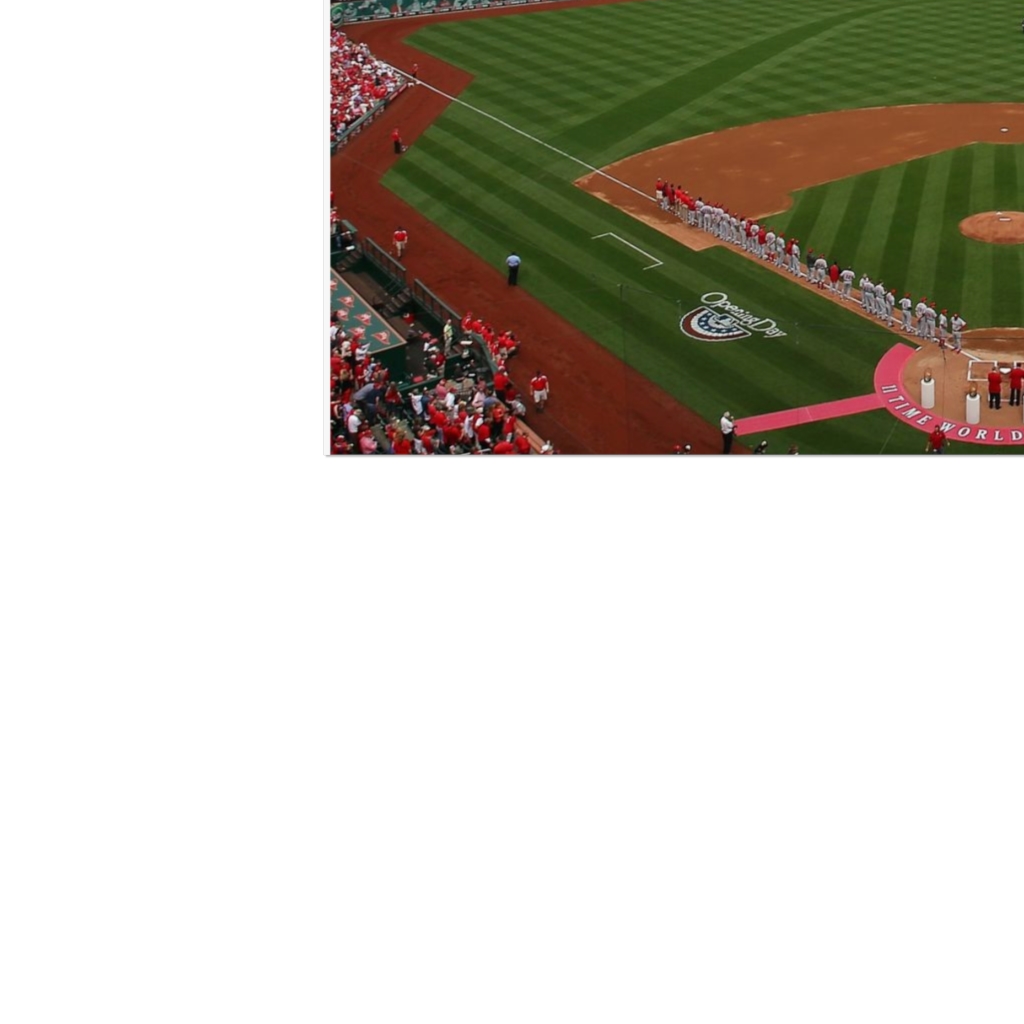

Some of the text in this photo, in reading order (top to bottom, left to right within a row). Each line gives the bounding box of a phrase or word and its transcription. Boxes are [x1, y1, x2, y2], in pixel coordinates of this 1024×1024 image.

[700, 291, 787, 338] Opening Day
[887, 396, 932, 425] TIME
[939, 421, 1024, 441] WORLD
